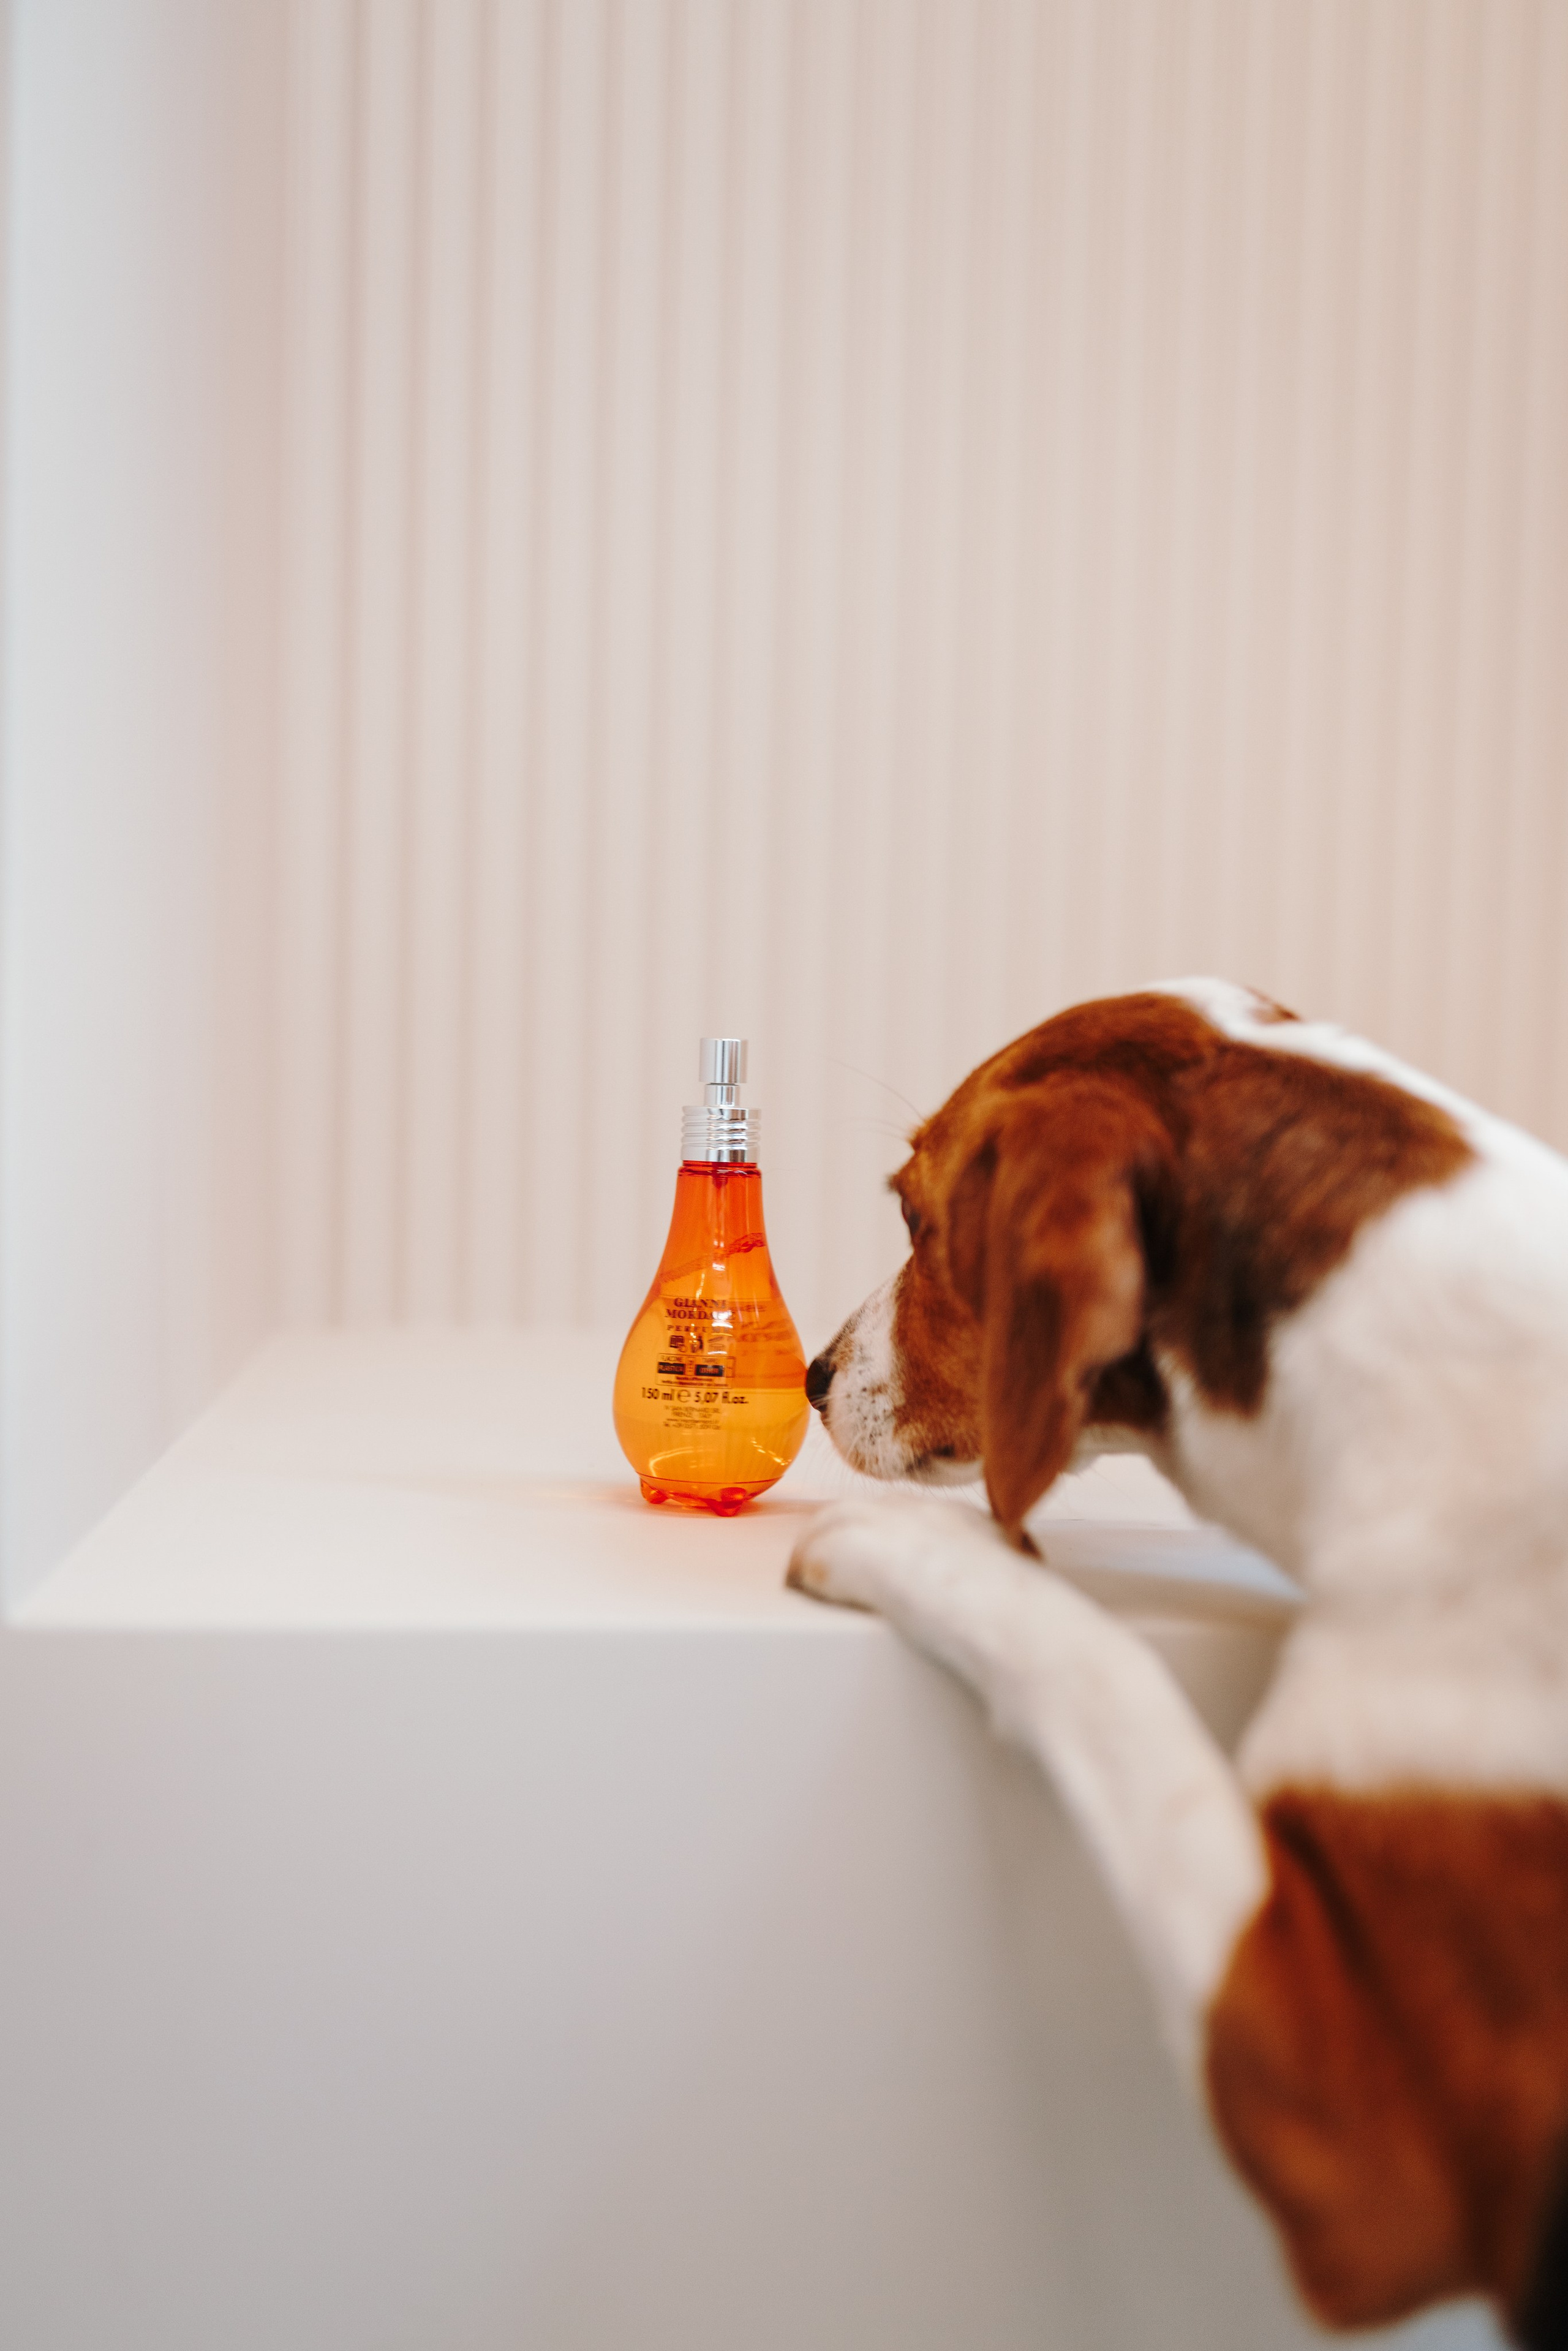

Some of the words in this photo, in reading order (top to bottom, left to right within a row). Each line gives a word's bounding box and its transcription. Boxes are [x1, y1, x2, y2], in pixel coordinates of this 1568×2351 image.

[674, 1297, 726, 1309] GIANNI
[642, 1387, 660, 1400] 150
[662, 1388, 675, 1401] ml
[694, 1391, 719, 1405] 5,07
